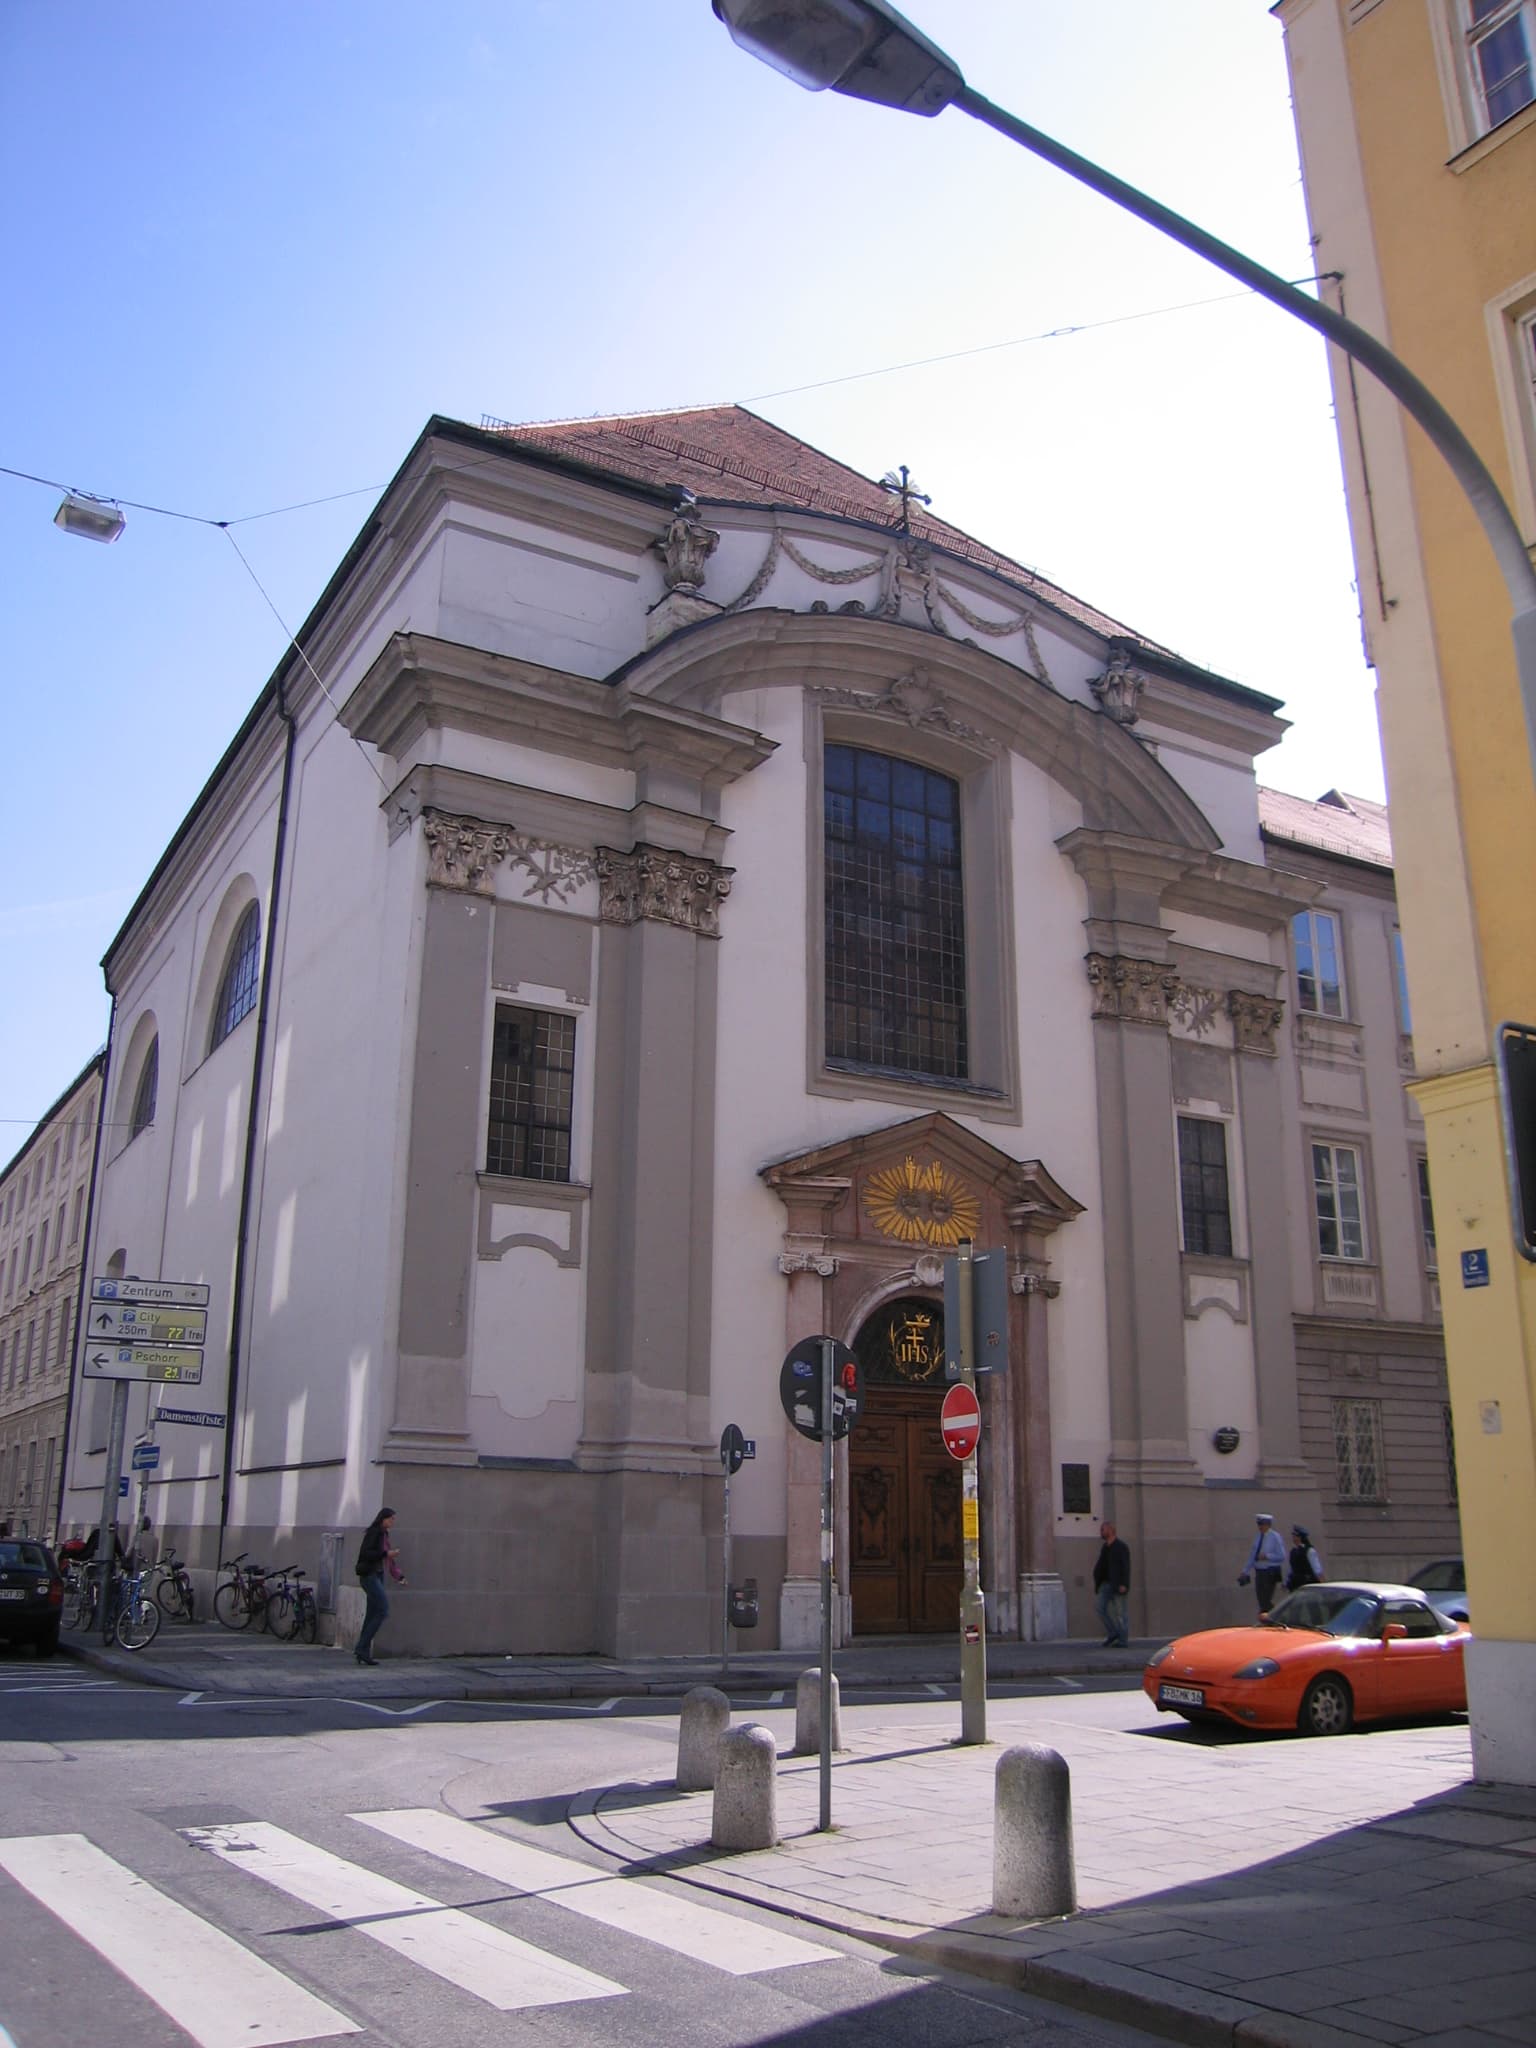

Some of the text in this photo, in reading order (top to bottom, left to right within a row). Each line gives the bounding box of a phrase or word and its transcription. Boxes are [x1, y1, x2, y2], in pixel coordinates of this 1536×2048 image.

[1468, 1253, 1479, 1271] 2
[104, 1284, 173, 1298] P Zentrum
[139, 1311, 161, 1324] City
[117, 1324, 203, 1340] 250m 77 frei
[134, 1351, 179, 1363] Pschorr
[901, 1343, 929, 1364] IHS
[184, 1369, 200, 1380] frei
